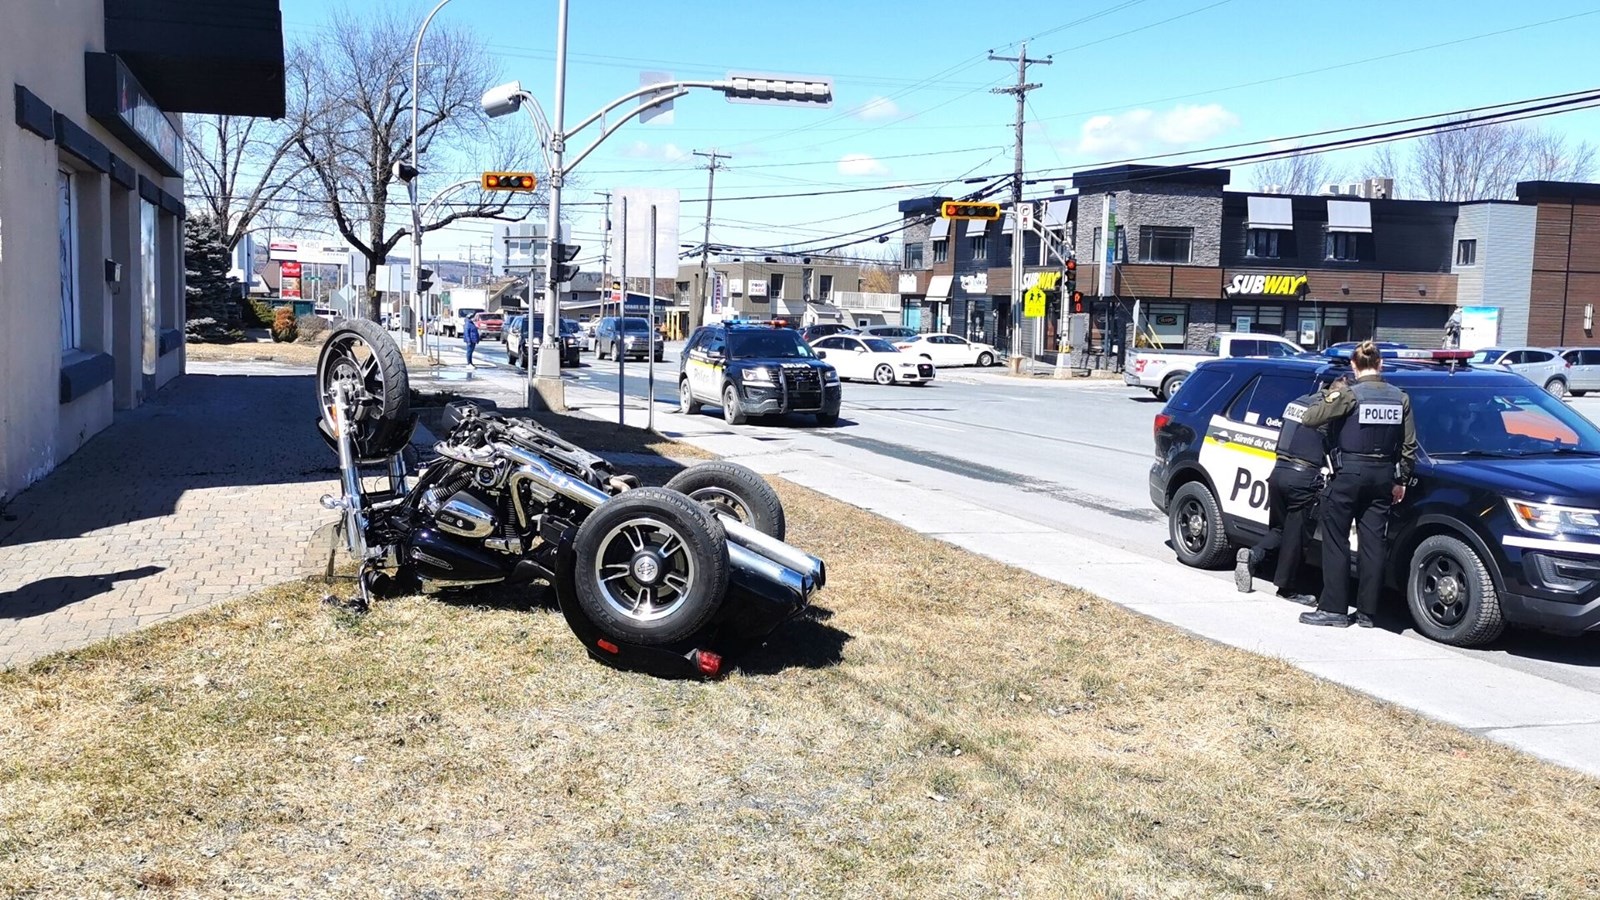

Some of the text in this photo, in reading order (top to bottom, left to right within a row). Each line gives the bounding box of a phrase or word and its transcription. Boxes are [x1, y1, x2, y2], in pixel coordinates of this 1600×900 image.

[1226, 275, 1307, 294] SUBWAY
[1365, 408, 1399, 420] POLICE
[1233, 433, 1254, 446] Sûreté
[1254, 438, 1263, 448] du
